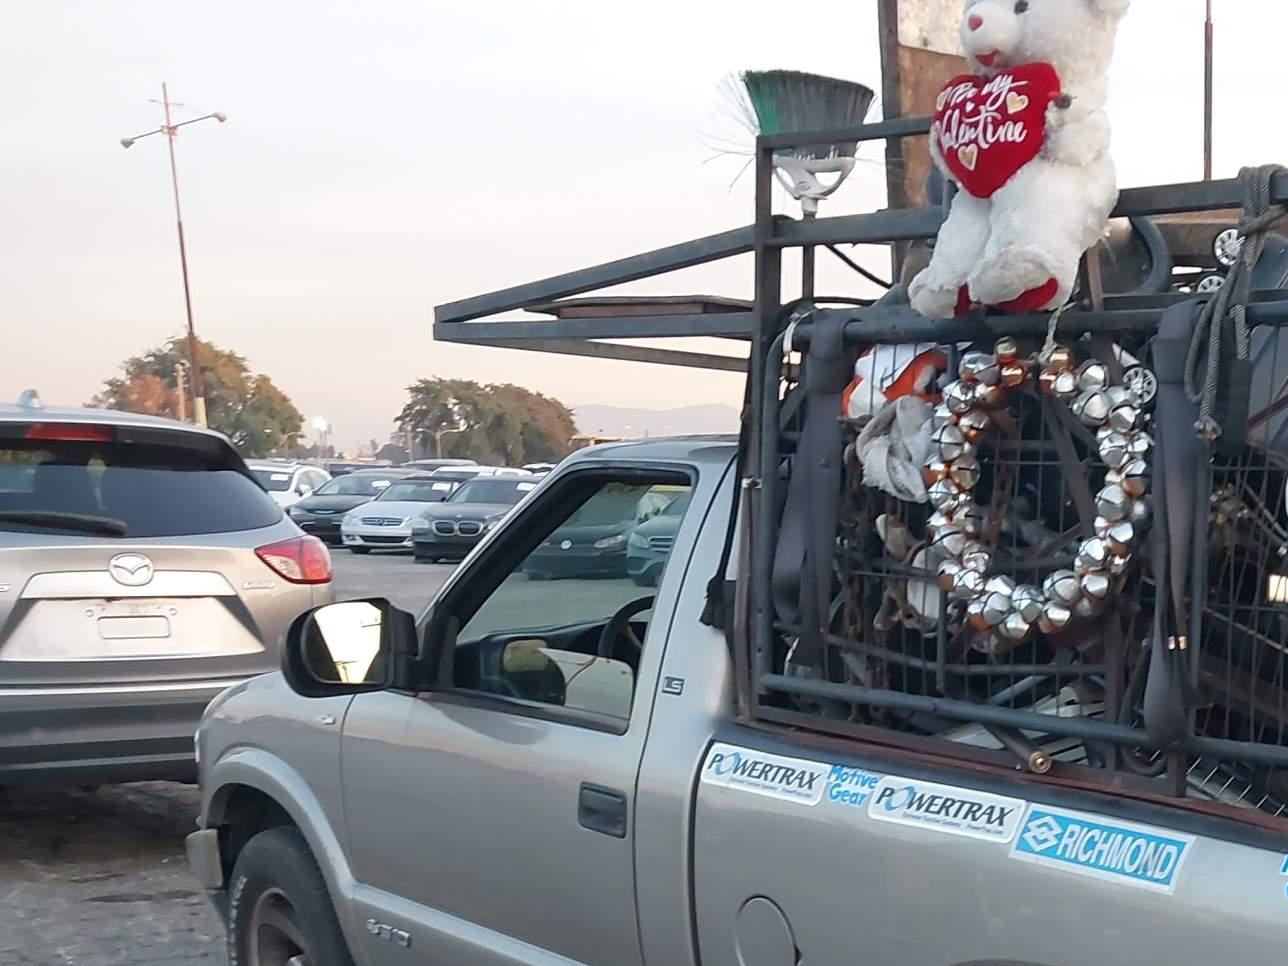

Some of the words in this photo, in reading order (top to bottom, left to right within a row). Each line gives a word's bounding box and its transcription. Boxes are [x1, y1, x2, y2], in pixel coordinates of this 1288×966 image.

[981, 75, 1028, 111] my
[707, 752, 823, 790] POWERTRAX
[827, 765, 879, 789] Motive
[829, 783, 868, 806] Gear
[876, 785, 1015, 827] POWERTRAX
[1056, 823, 1179, 880] RICHMOND
